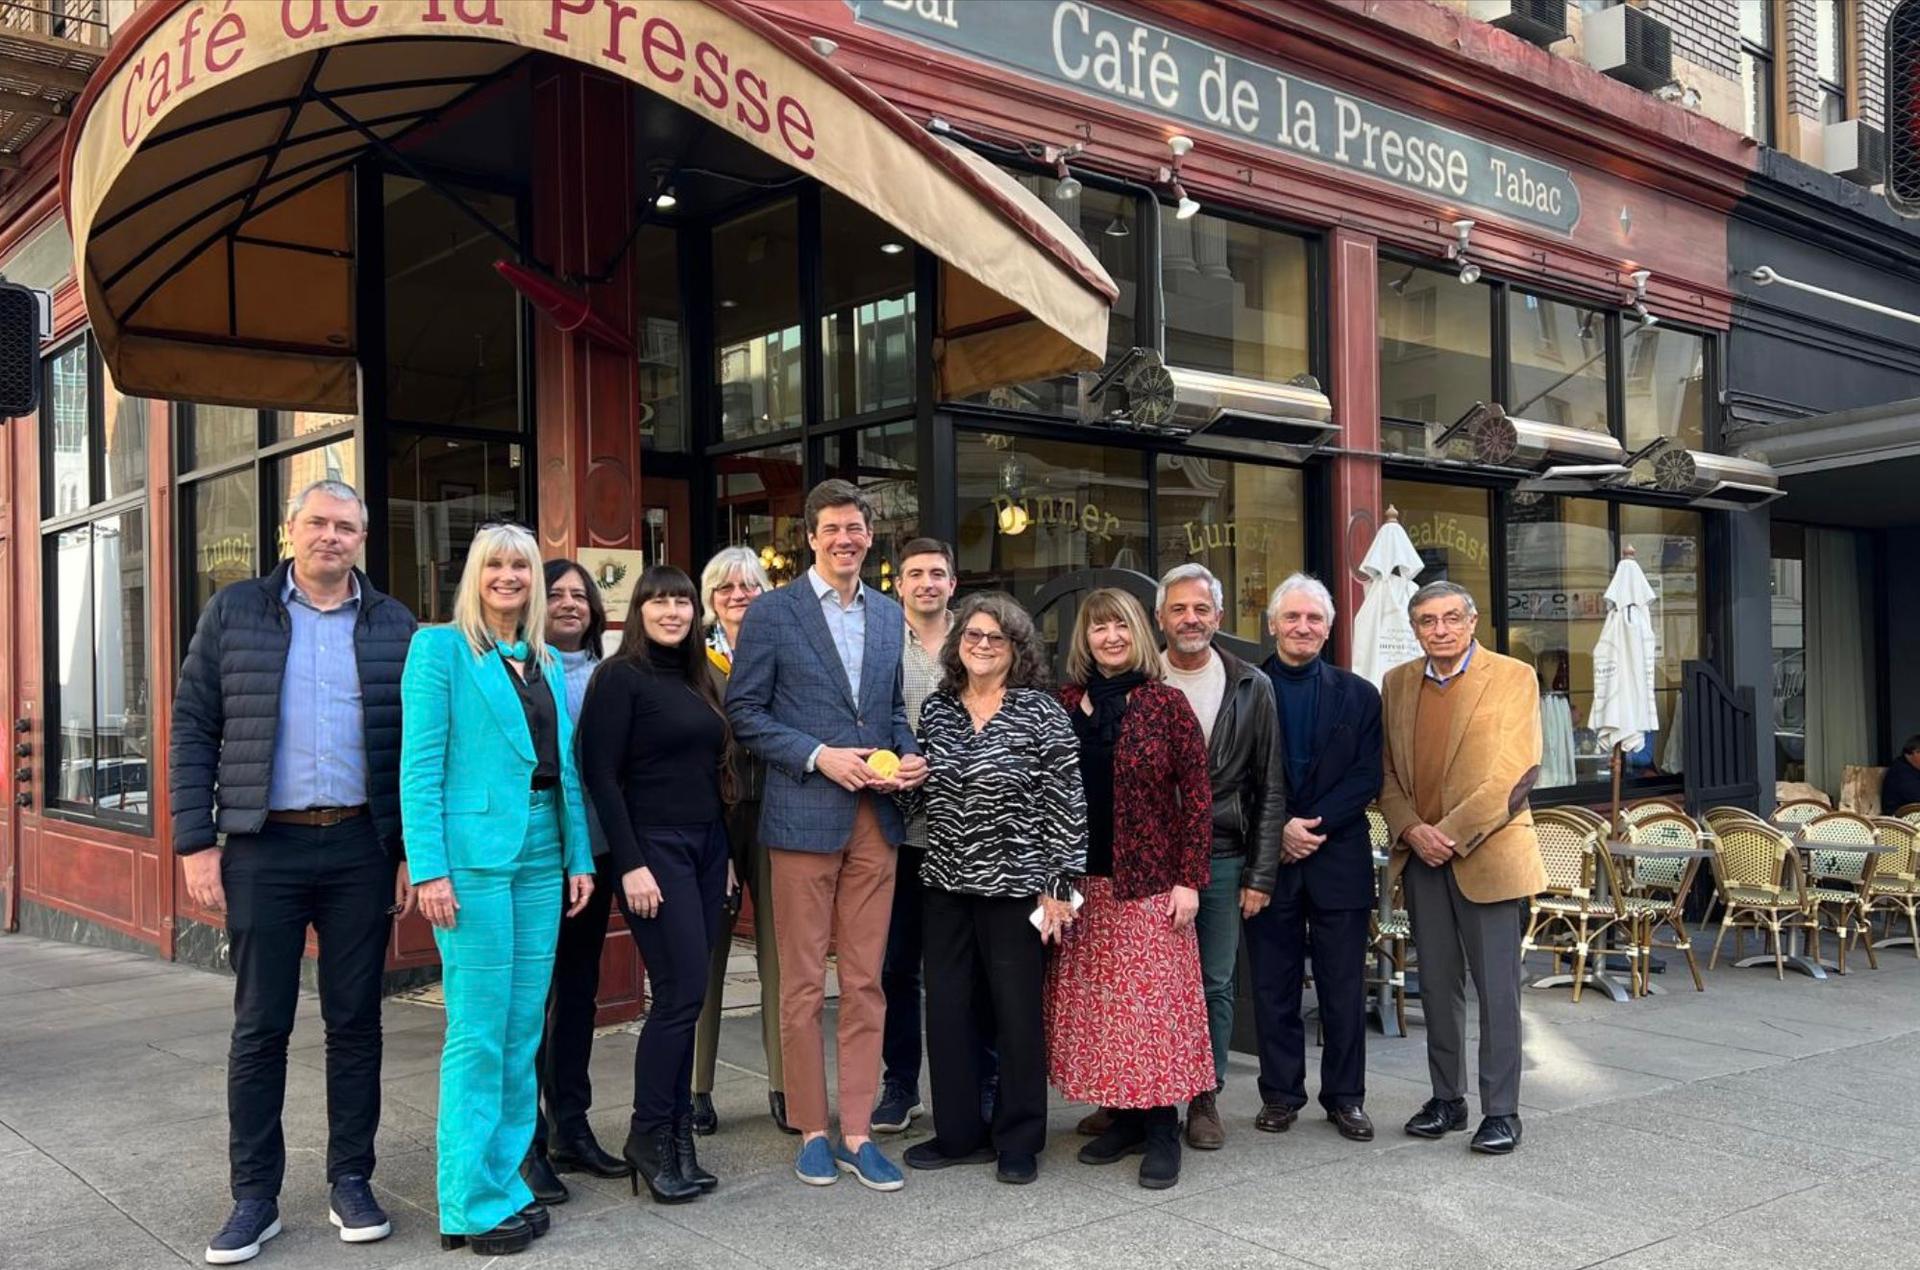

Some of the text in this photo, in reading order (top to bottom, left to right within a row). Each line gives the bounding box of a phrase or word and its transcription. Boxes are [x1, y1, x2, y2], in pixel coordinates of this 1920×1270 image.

[121, 0, 246, 148] Café
[882, 0, 1562, 217] ar Café de la Presse Tabac
[992, 488, 1120, 541] Dinner
[1404, 510, 1489, 571] eakfast
[204, 532, 251, 573] Lunch
